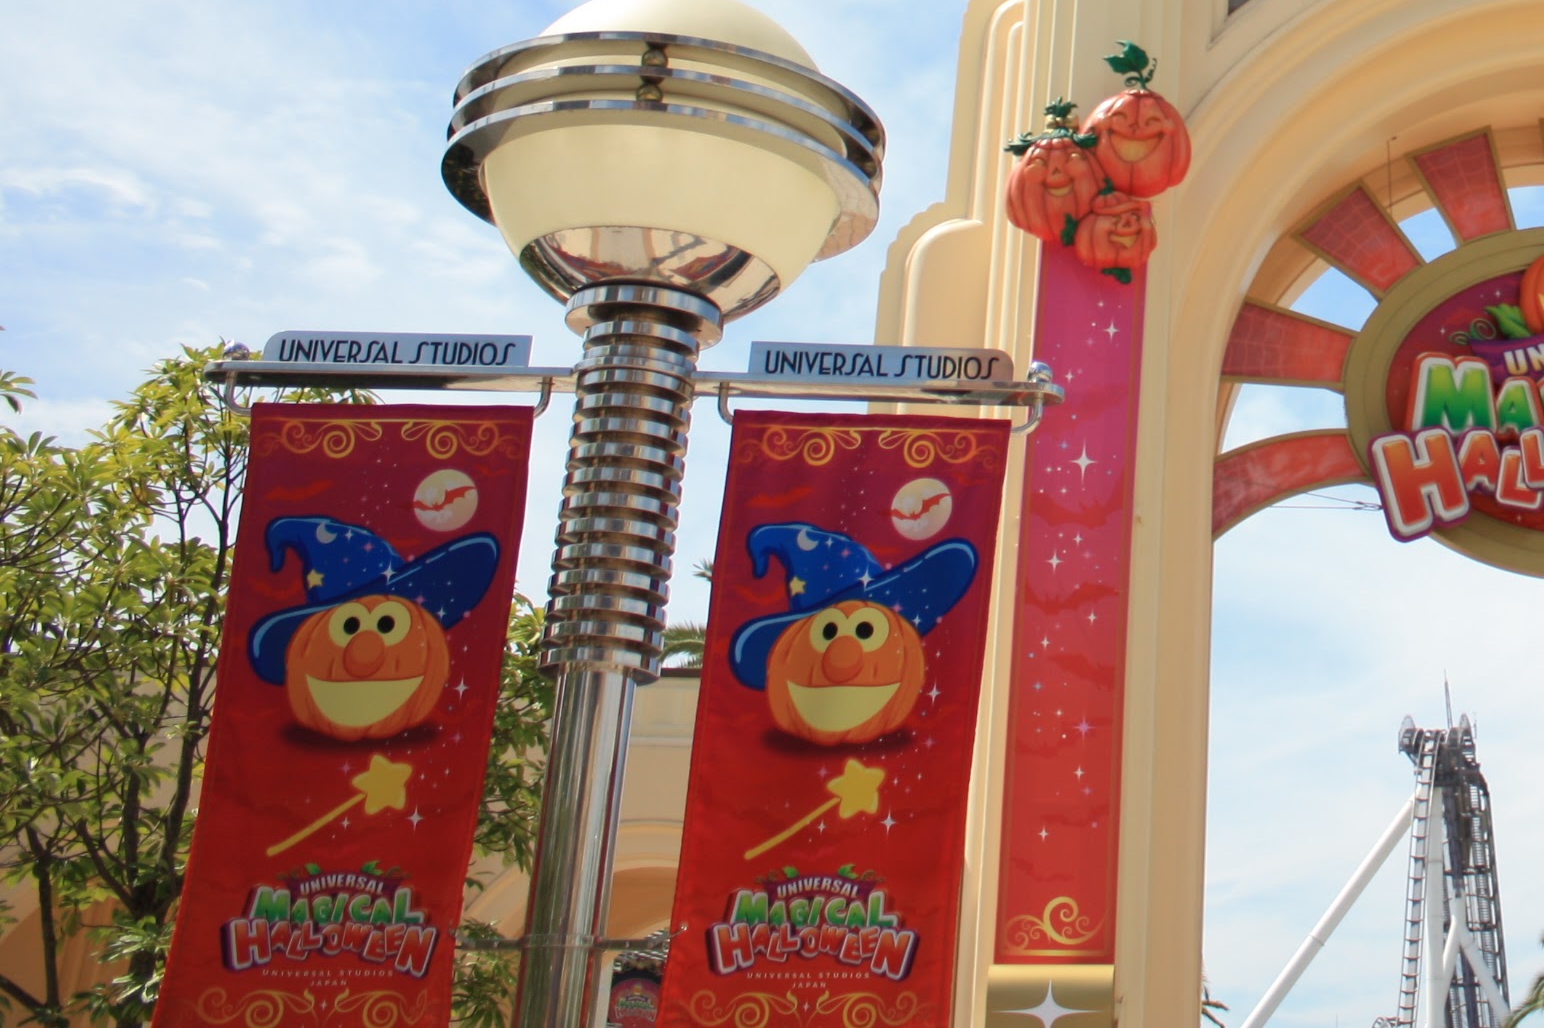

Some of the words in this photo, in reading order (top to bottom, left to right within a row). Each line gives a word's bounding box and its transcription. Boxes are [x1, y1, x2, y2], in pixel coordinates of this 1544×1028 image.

[279, 339, 402, 364] UNIVERSAL
[409, 340, 516, 366] STUDIOS
[764, 350, 888, 378] UNIVERSAL
[894, 354, 1000, 381] STUDIOS
[300, 874, 386, 895] UNIVERSAL
[777, 877, 860, 897] UNIVERSAL
[250, 886, 425, 924] MAGICAL
[731, 890, 898, 928] MAGICAL
[230, 919, 438, 977] HALLOWEEN
[714, 922, 915, 980] HALLOWEEN
[261, 968, 332, 977] UNIVERSAL
[339, 969, 394, 977] STUDIOS
[309, 979, 348, 987] JAPAN
[746, 971, 812, 979] UNIVERSAL
[791, 981, 827, 989] JAPAN
